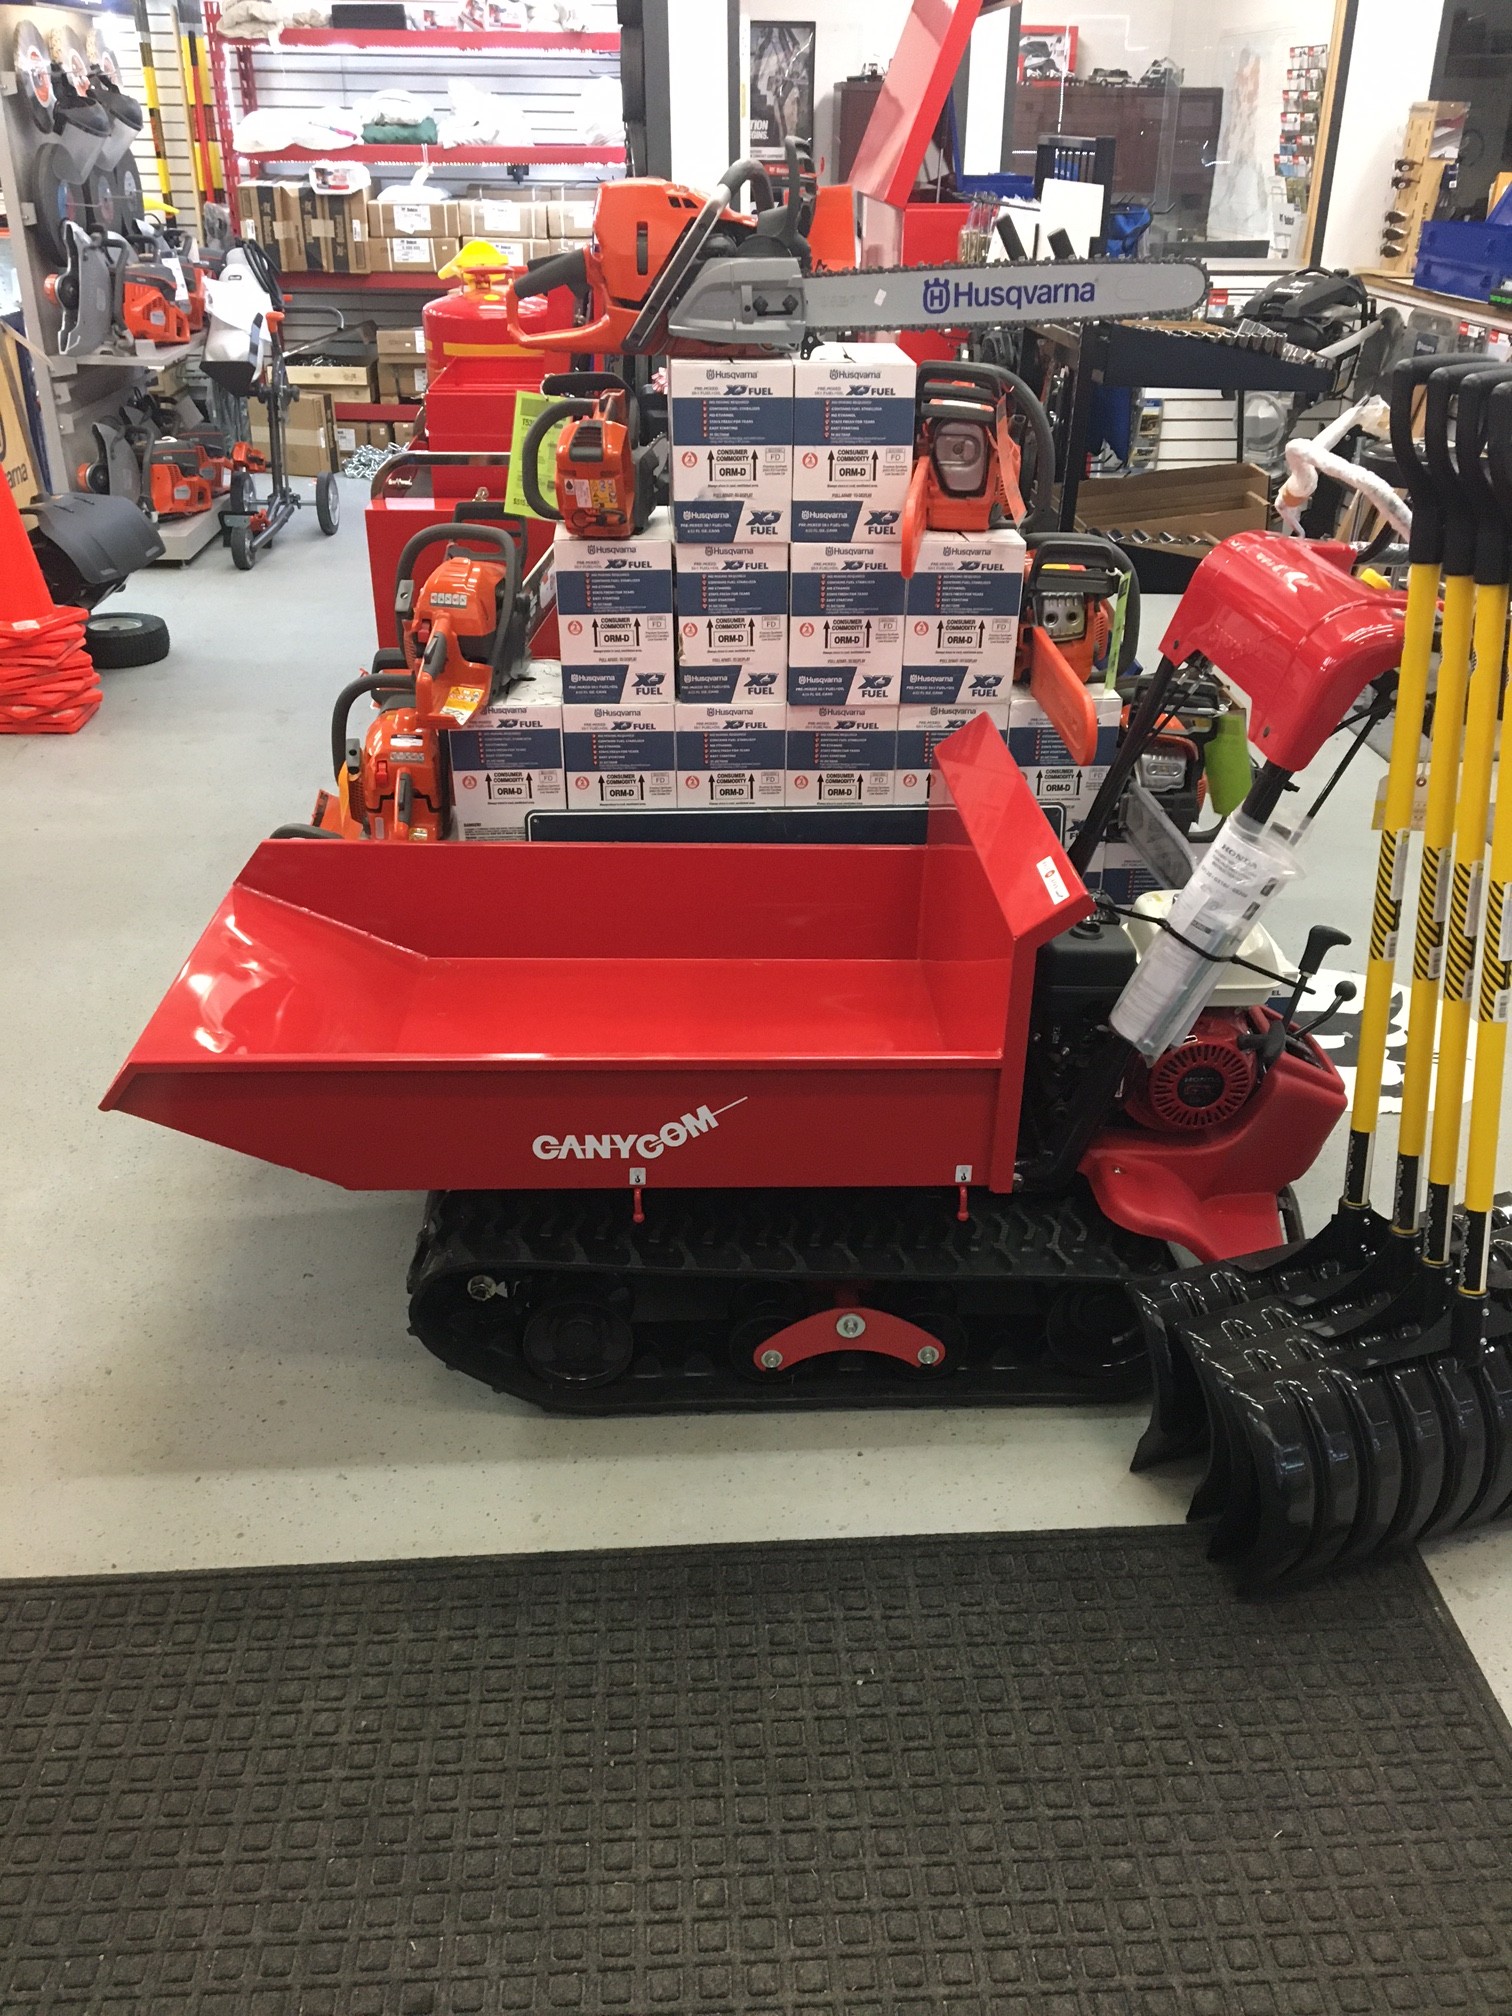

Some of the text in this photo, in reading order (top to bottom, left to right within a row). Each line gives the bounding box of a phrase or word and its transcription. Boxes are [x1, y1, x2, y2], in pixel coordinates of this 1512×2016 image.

[750, 120, 768, 130] TION
[750, 131, 768, 139] GINS.
[954, 282, 1095, 310] Husqvarna
[716, 371, 758, 379] Husqvarna
[839, 371, 880, 379] Husqvarna
[810, 511, 847, 519] Husqvarna
[868, 527, 896, 535] FUEL
[532, 1104, 719, 1160] CANYCOM
